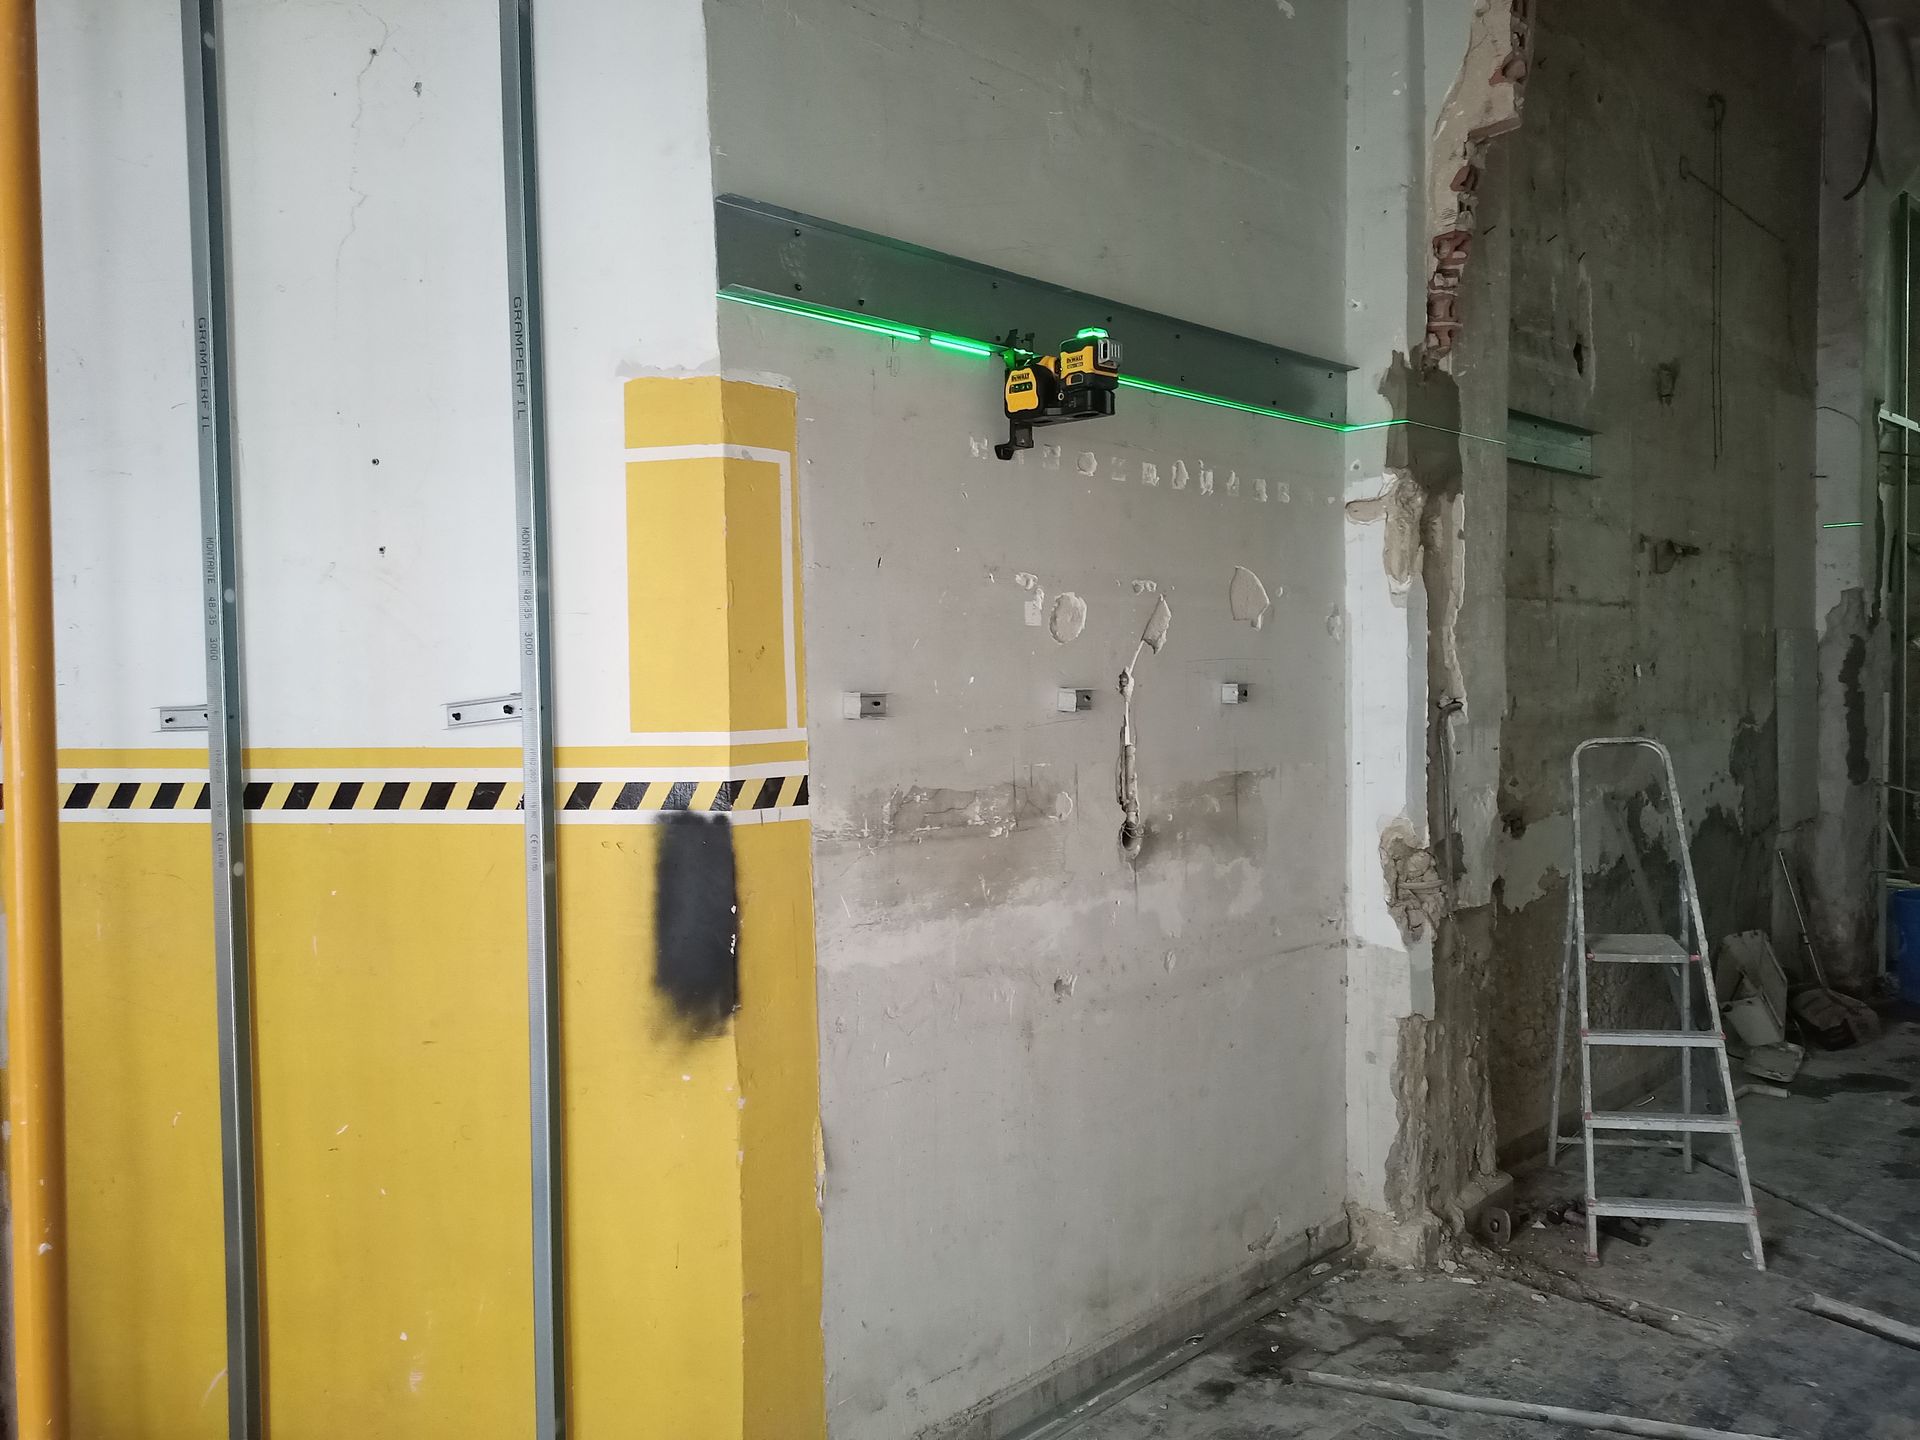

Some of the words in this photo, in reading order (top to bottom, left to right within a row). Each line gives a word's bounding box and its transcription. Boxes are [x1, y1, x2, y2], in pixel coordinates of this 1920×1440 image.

[206, 537, 216, 585] MONTANTE
[521, 527, 531, 576] MONTANTE
[208, 597, 217, 626] 48/35
[523, 589, 533, 618] 48/35
[210, 638, 218, 661] 3000
[525, 632, 534, 656] 3000
